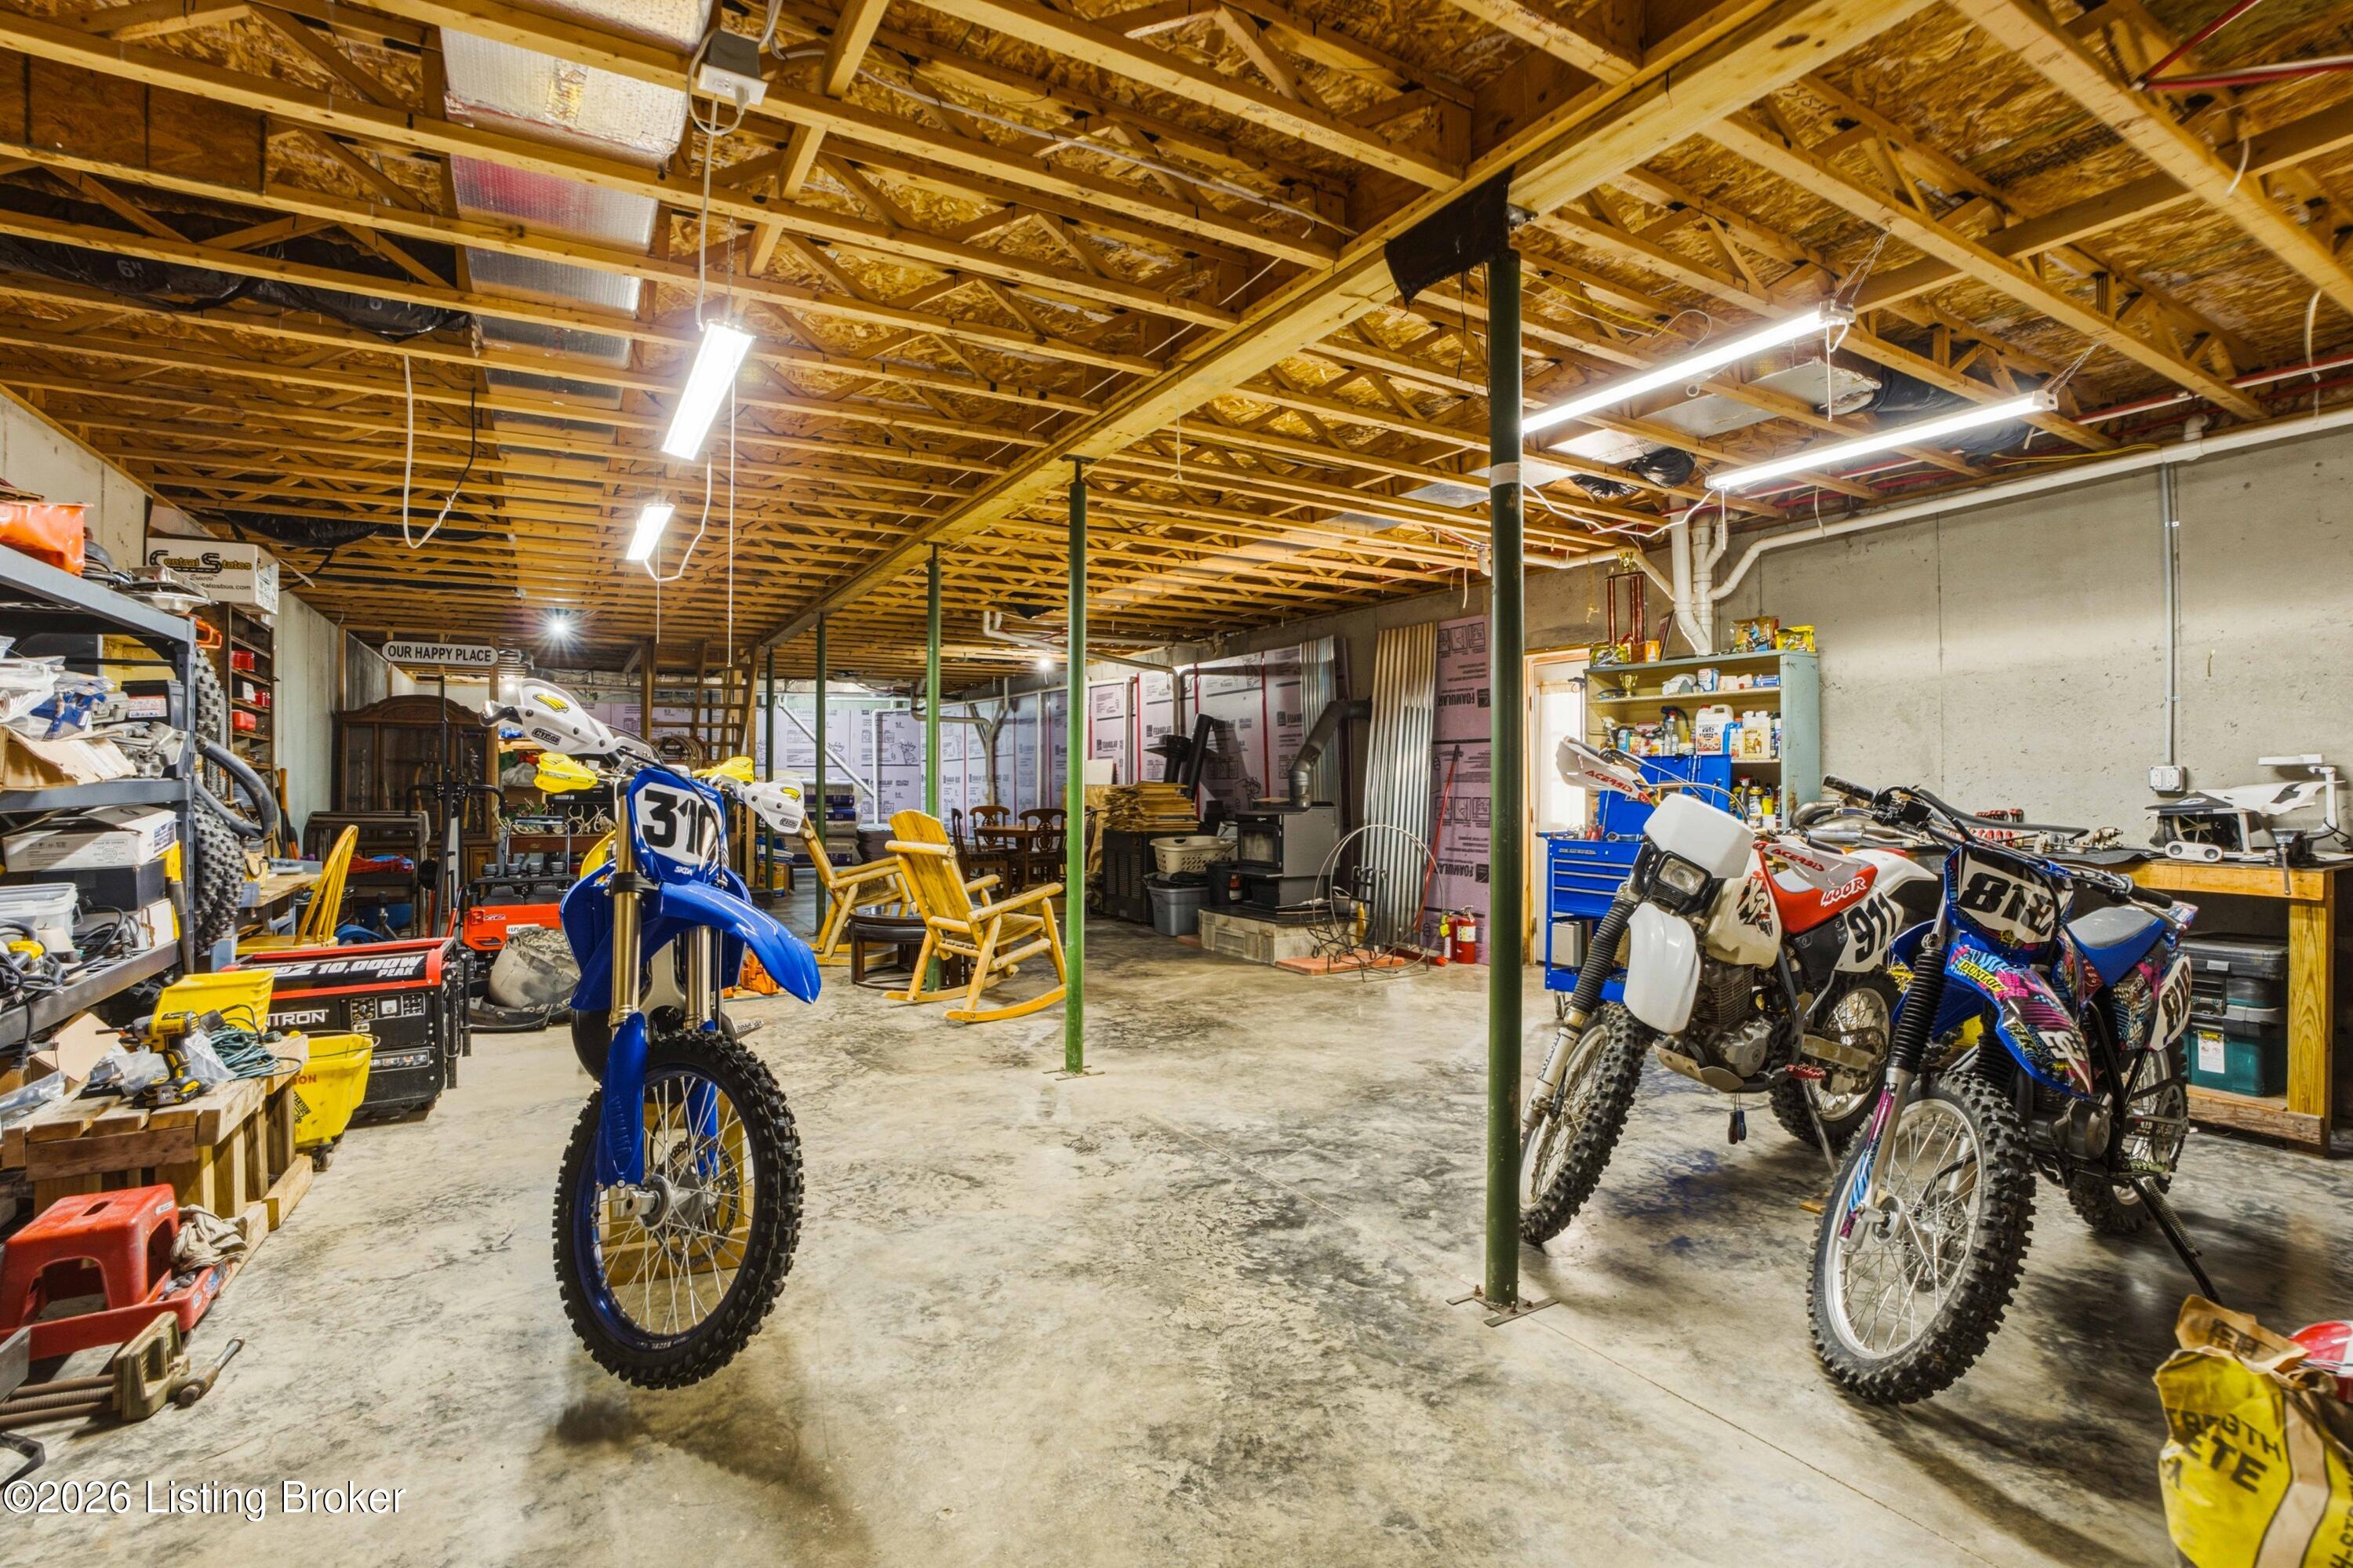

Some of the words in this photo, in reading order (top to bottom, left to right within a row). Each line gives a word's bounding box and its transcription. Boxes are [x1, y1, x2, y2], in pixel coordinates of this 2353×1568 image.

[150, 550, 200, 569] Central
[202, 552, 253, 573] States
[388, 646, 412, 658] OUR
[415, 646, 453, 660] HAPPY
[456, 649, 492, 662] PLACE
[1820, 876, 1867, 907] 400R
[1846, 892, 1897, 963] 911
[317, 955, 425, 975] 10,000W
[376, 967, 415, 978] PEAK
[1961, 961, 2005, 991] DUNLOP
[266, 1010, 327, 1027] NTRON
